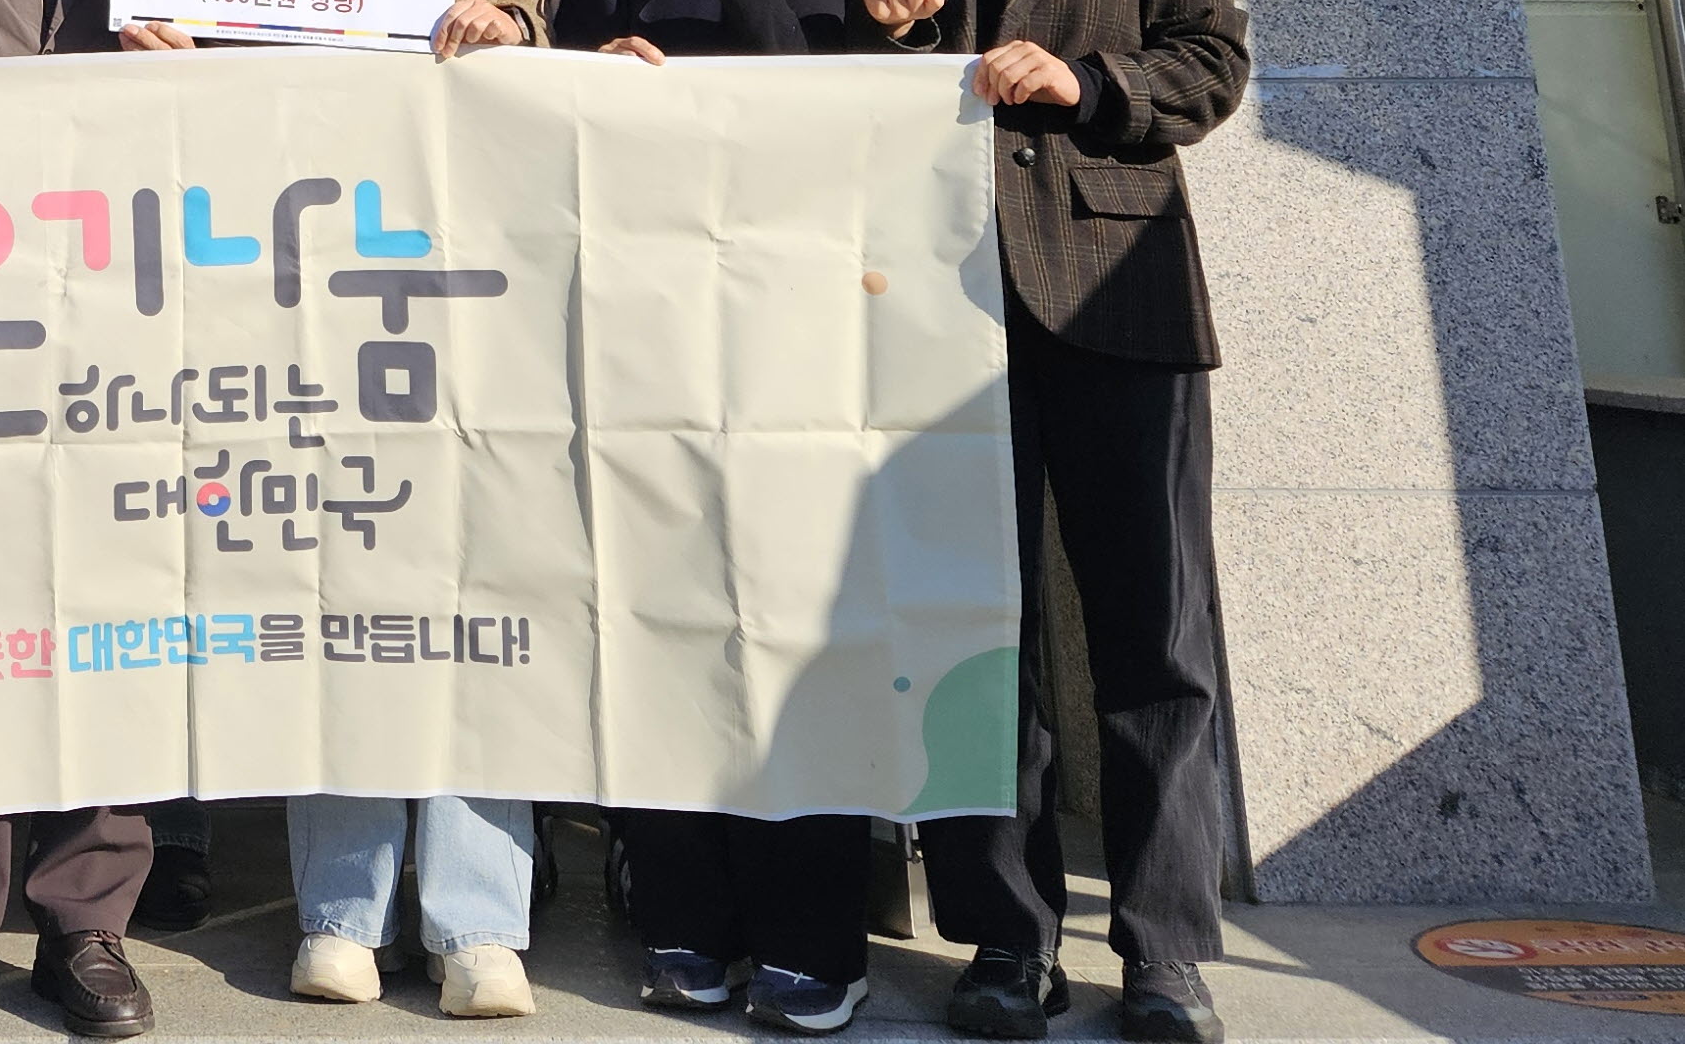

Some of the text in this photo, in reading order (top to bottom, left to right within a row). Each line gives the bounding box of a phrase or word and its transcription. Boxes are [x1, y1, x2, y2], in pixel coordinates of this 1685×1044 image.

[57, 363, 339, 449] 하나되는
[113, 449, 413, 552] 대한민국
[68, 614, 306, 673] 대한민국을
[320, 614, 531, 668] 만듭니다!
